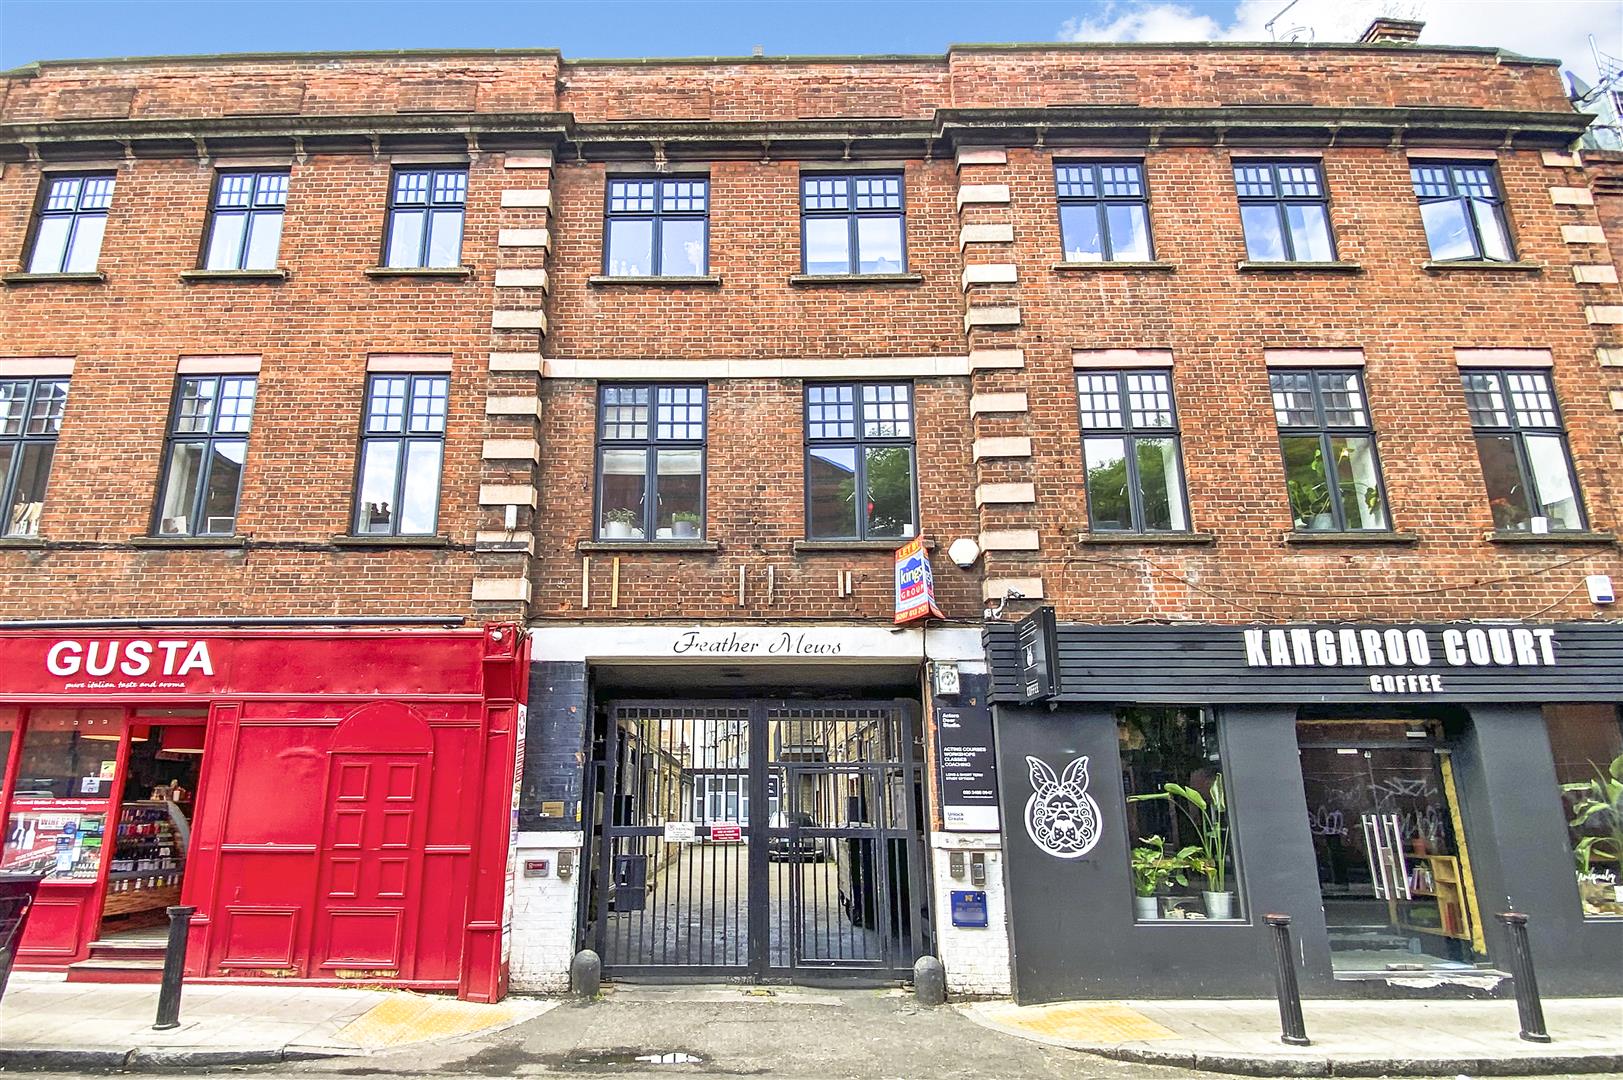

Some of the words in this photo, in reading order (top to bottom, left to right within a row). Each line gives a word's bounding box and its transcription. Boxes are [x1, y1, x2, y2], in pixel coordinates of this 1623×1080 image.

[898, 545, 911, 558] LET
[900, 566, 923, 585] kings
[673, 631, 759, 653] Feather
[768, 631, 841, 654] Mews
[1243, 628, 1432, 667] KANGAROO
[1442, 628, 1556, 667] COURT
[47, 640, 215, 676] GUSTA
[65, 682, 85, 690] pure
[1369, 674, 1444, 693] COFFEE
